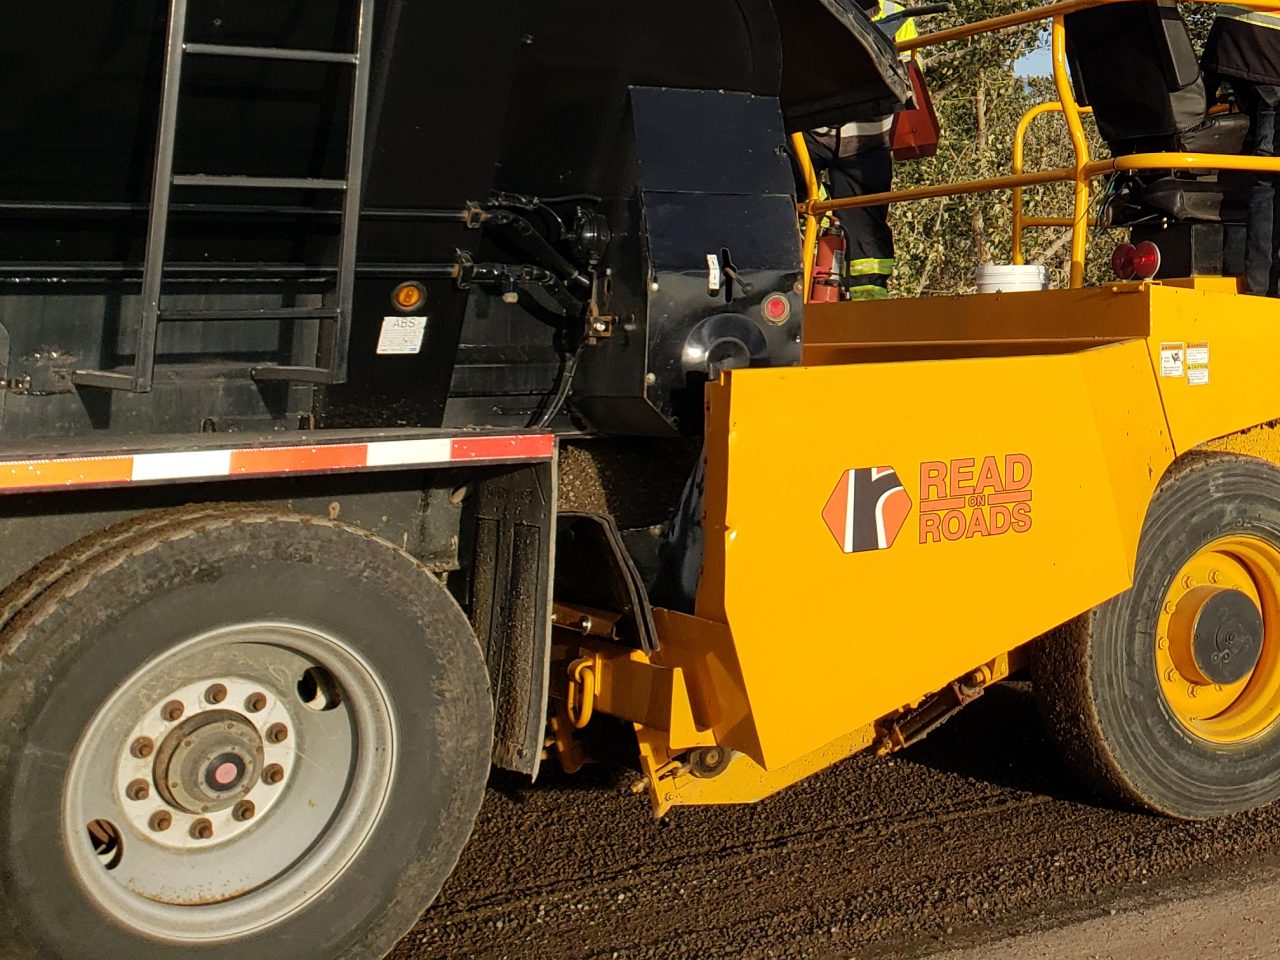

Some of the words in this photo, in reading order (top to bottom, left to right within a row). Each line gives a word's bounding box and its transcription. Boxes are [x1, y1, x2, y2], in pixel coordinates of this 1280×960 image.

[392, 318, 417, 328] ABS
[919, 453, 1033, 500] READ
[967, 494, 986, 508] ON
[918, 502, 1033, 545] ROADS
